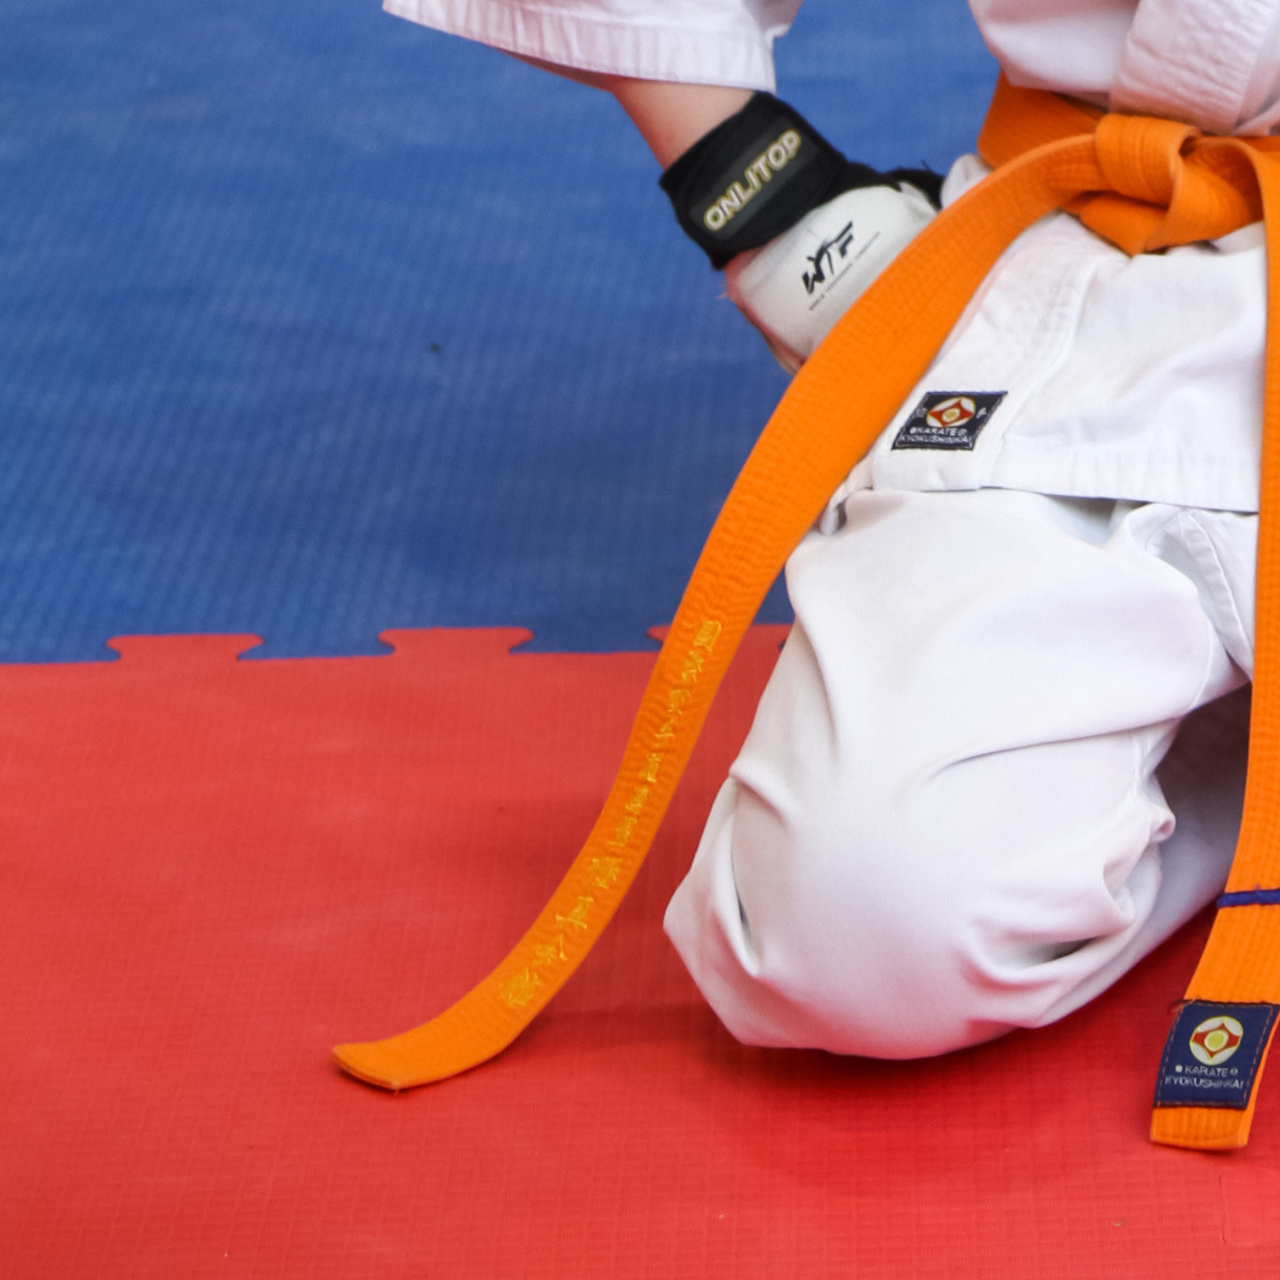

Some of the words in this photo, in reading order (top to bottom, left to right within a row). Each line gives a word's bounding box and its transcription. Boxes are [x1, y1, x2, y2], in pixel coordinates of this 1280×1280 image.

[704, 129, 801, 231] ONLITOP
[802, 220, 855, 295] WTF
[1184, 1065, 1228, 1077] KARATE
